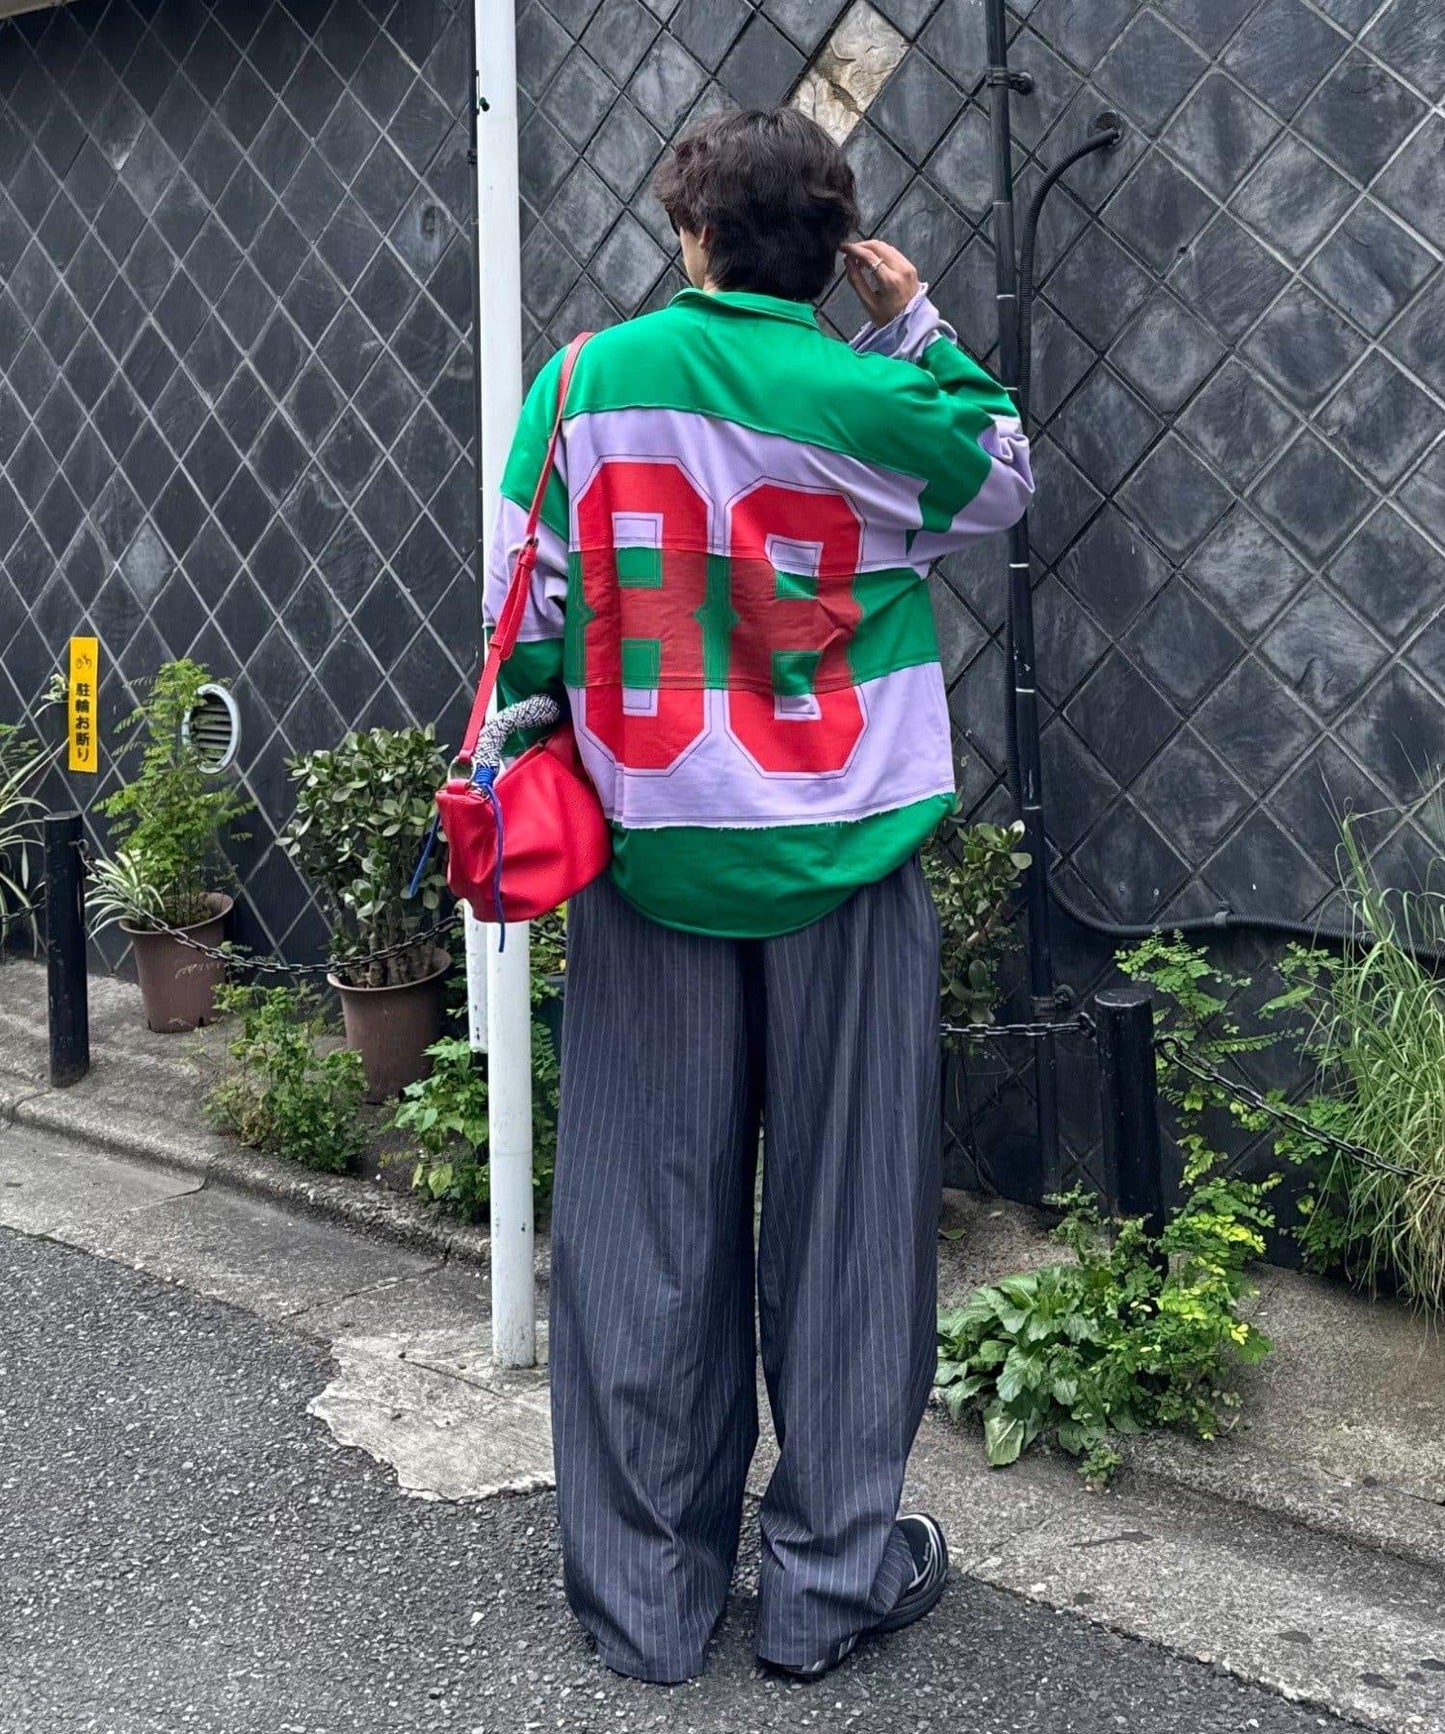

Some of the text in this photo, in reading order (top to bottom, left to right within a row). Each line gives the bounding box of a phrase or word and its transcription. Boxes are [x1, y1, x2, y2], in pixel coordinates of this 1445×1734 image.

[574, 459, 867, 776] 88
[75, 682, 91, 762] 駐輪お断り
